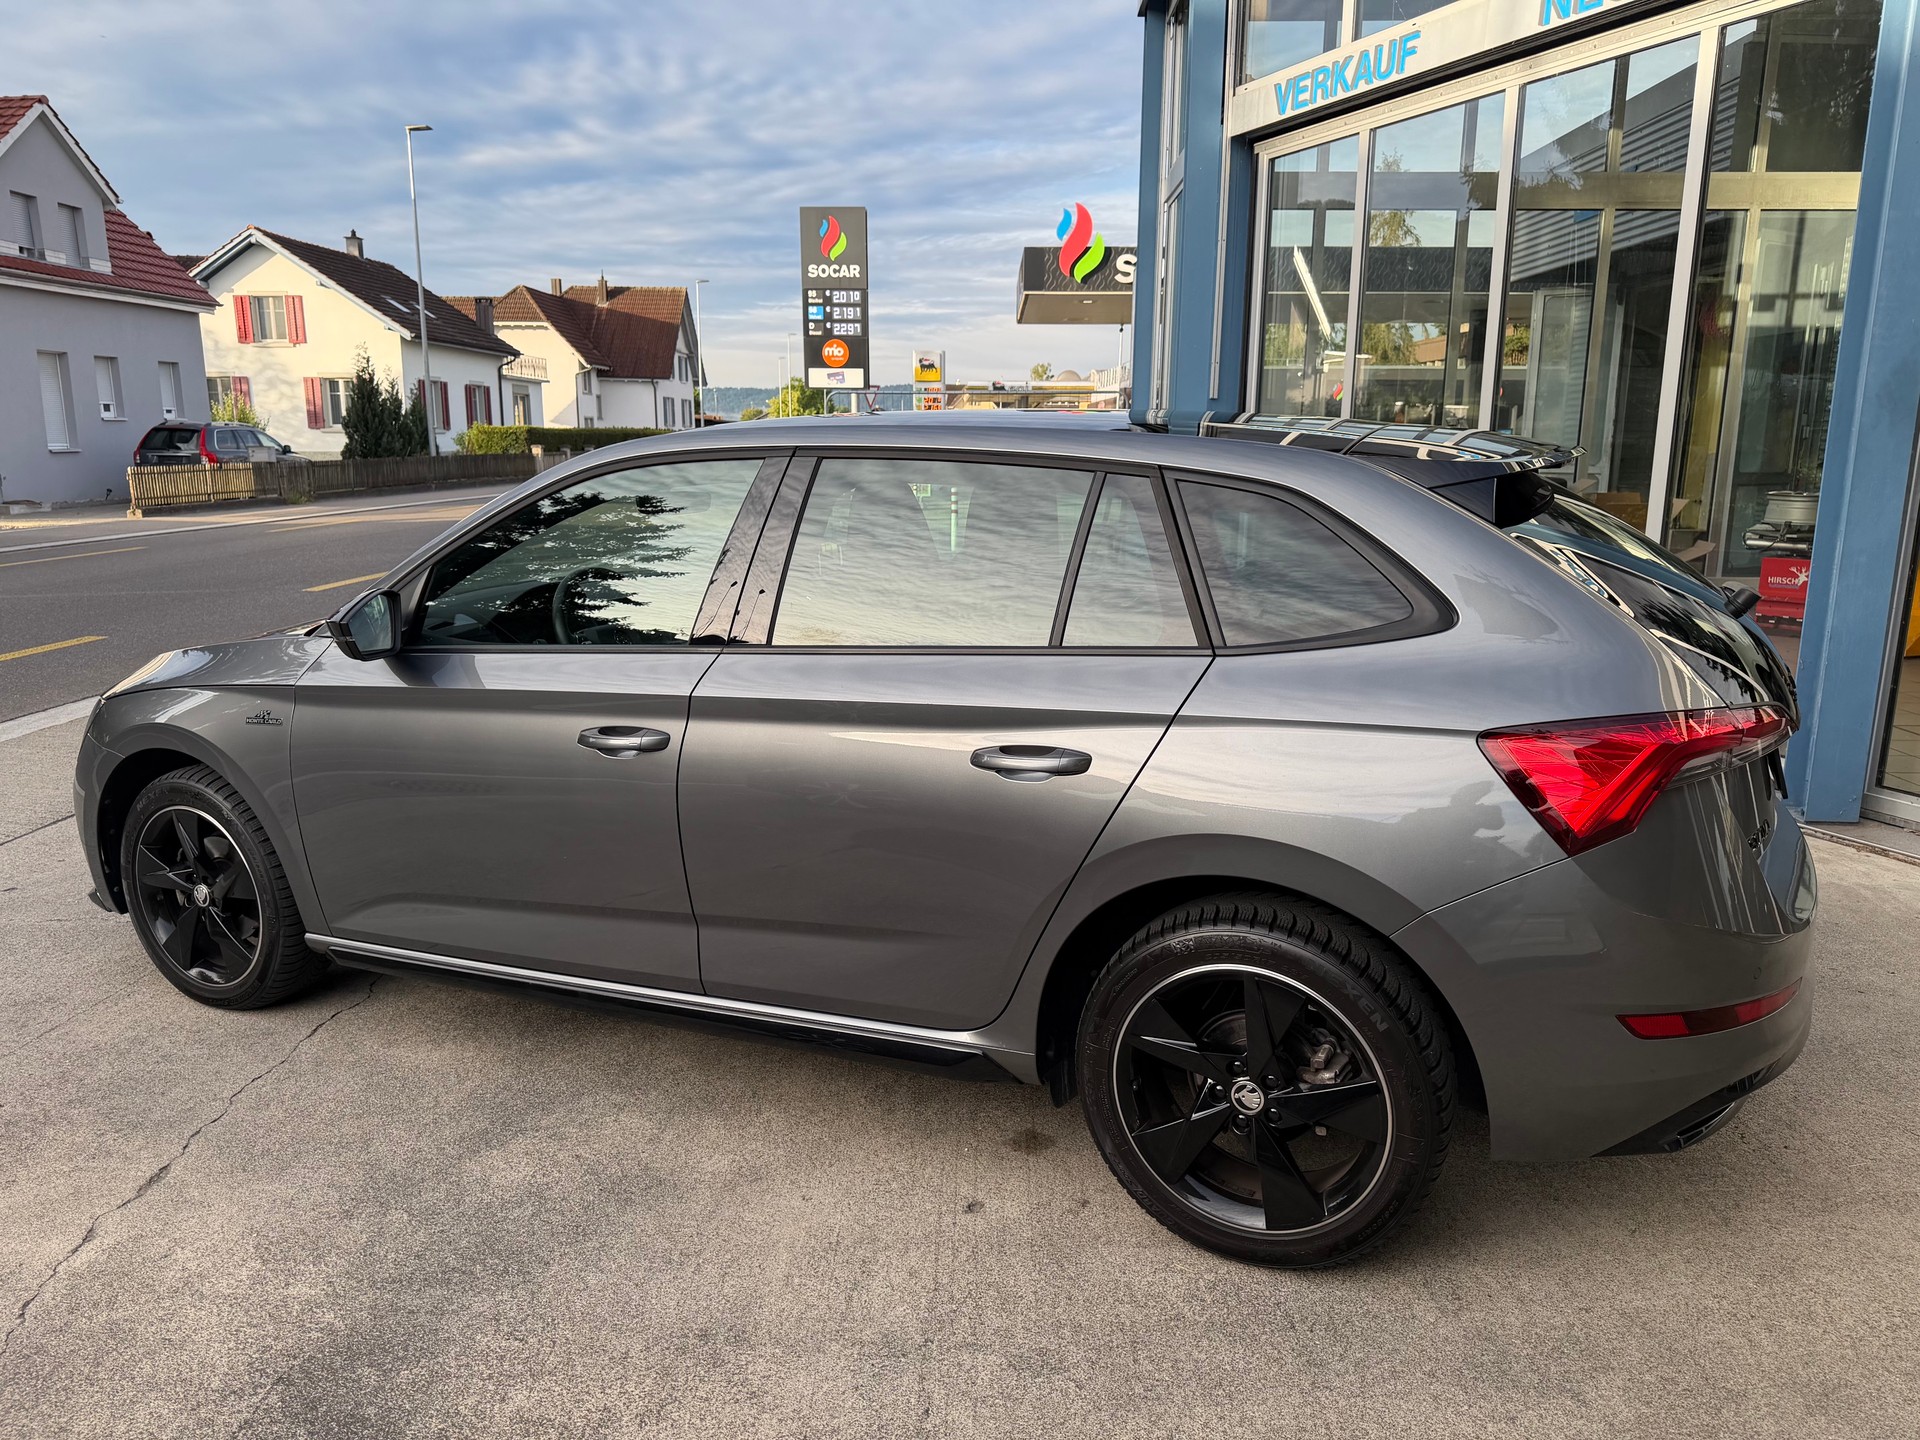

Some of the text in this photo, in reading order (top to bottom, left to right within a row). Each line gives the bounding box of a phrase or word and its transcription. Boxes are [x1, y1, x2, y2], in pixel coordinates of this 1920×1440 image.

[1274, 31, 1421, 115] VERKAUF
[808, 264, 861, 278] SOCAR
[1768, 576, 1798, 584] HIRSCH
